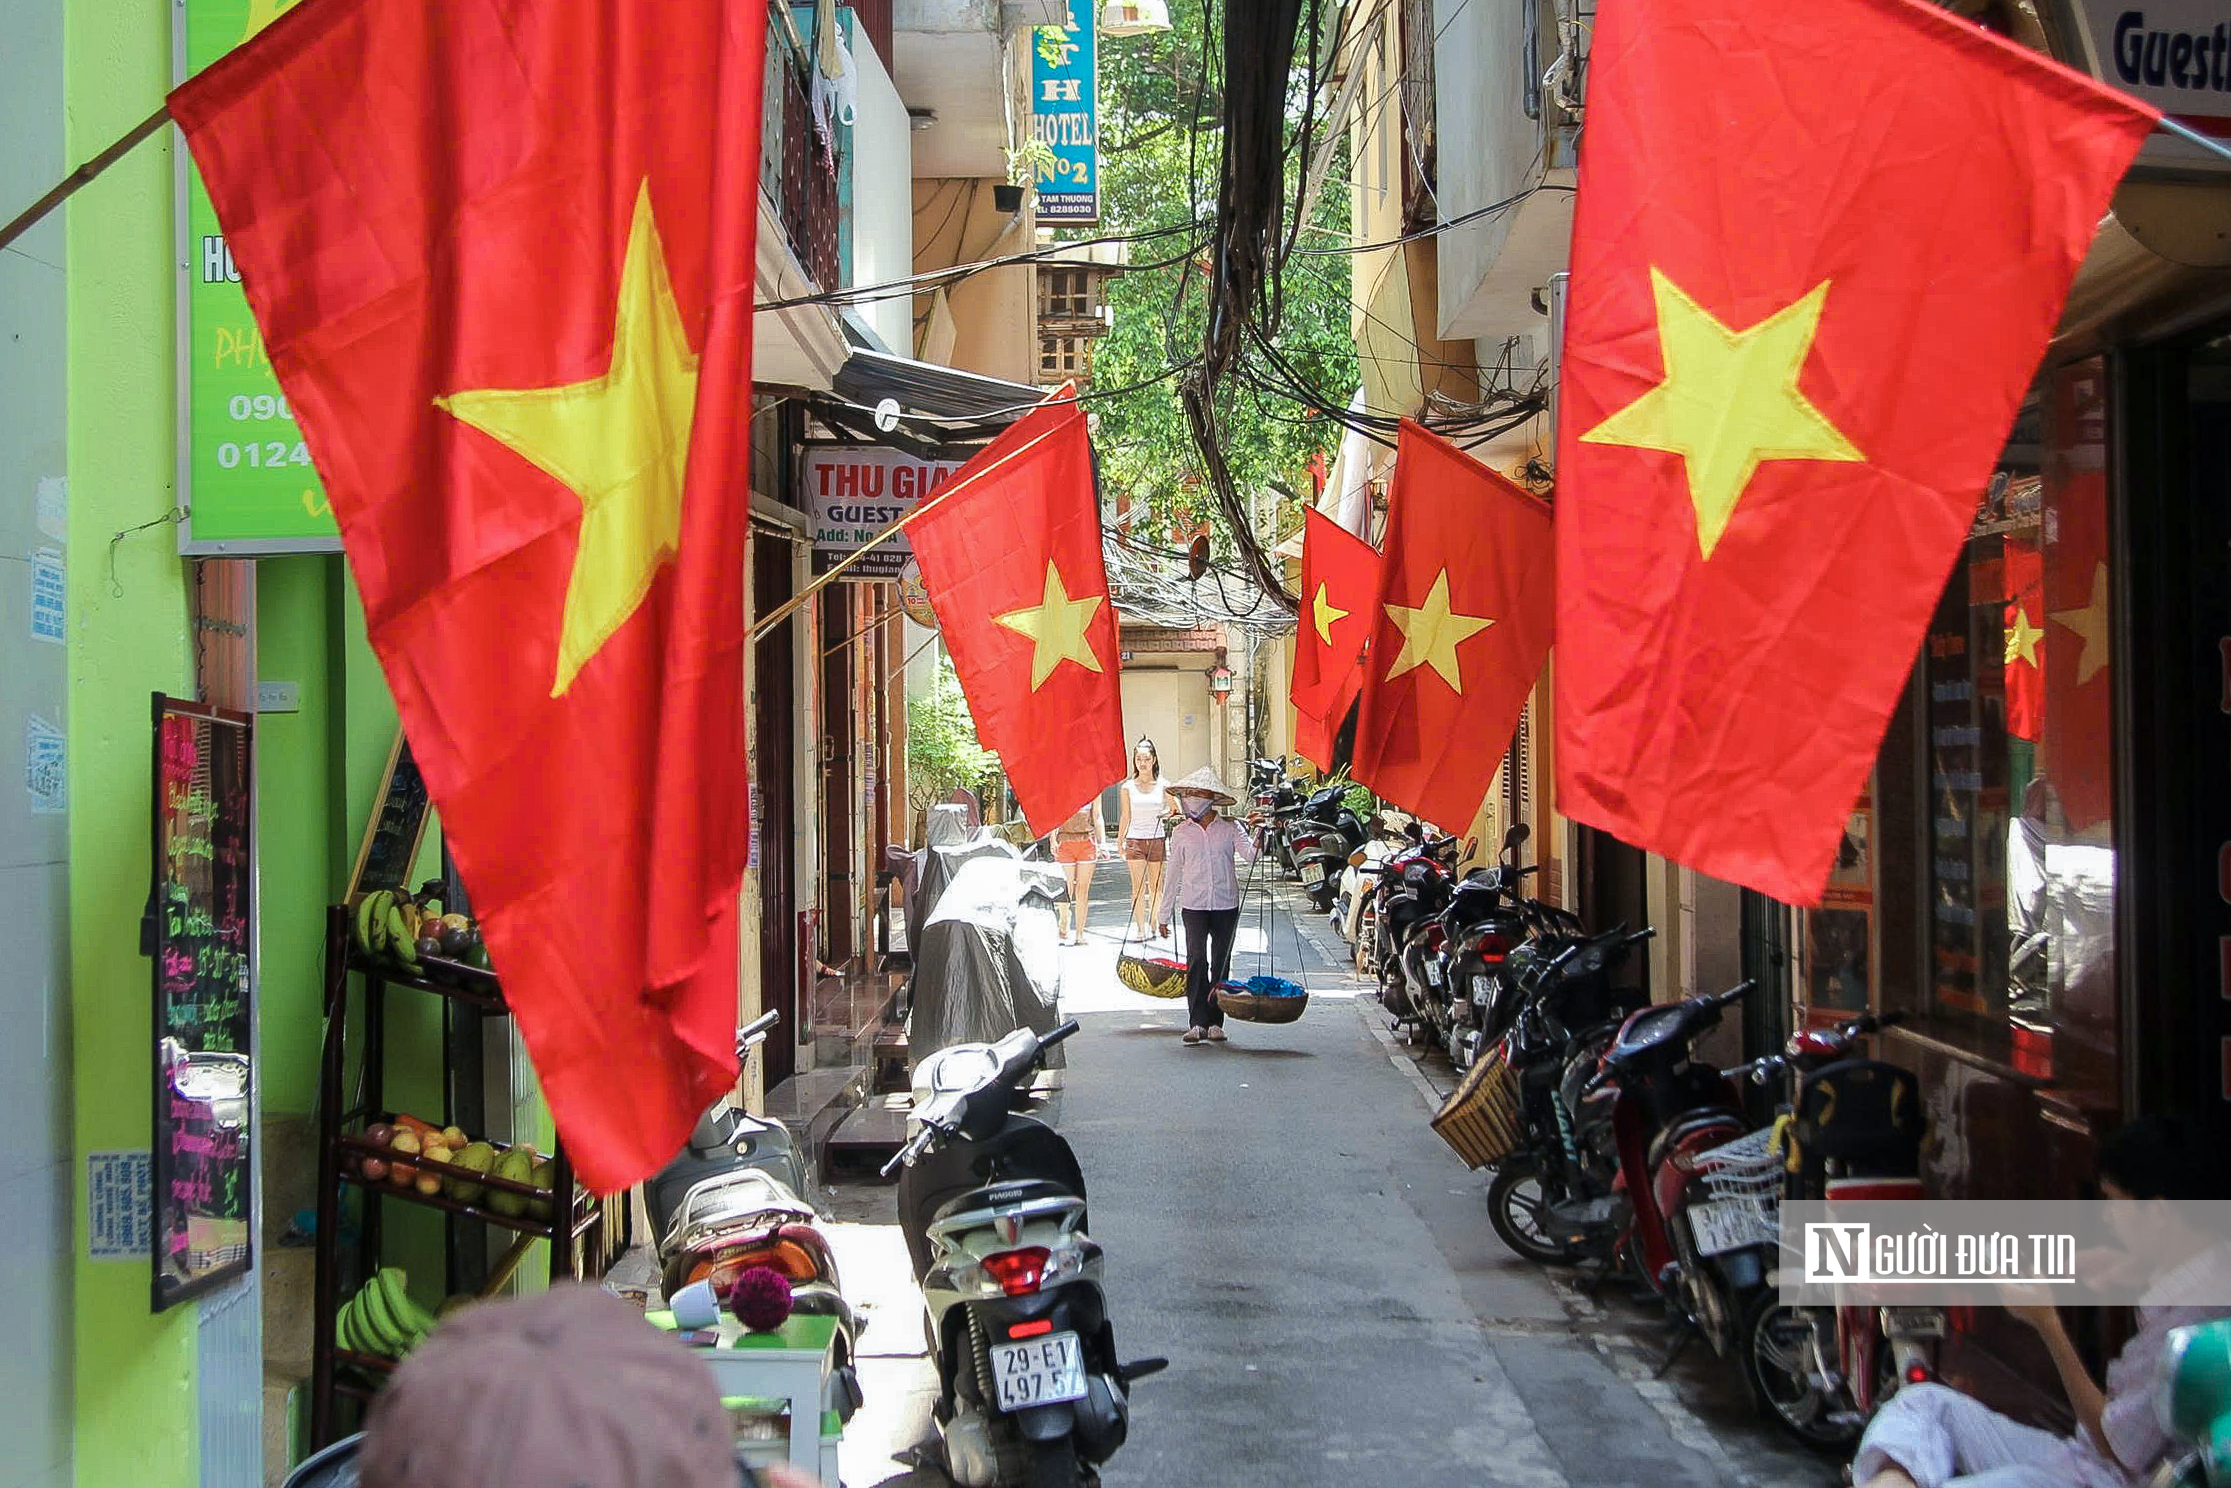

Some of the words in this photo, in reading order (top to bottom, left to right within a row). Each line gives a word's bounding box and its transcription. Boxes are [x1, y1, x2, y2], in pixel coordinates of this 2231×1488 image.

[2114, 11, 2231, 93] Guest
[1034, 113, 1092, 146] HOTEL
[815, 463, 885, 497] THU
[827, 505, 904, 524] GUEST
[817, 528, 849, 543] Add:
[1004, 1341, 1067, 1374] 29-E1
